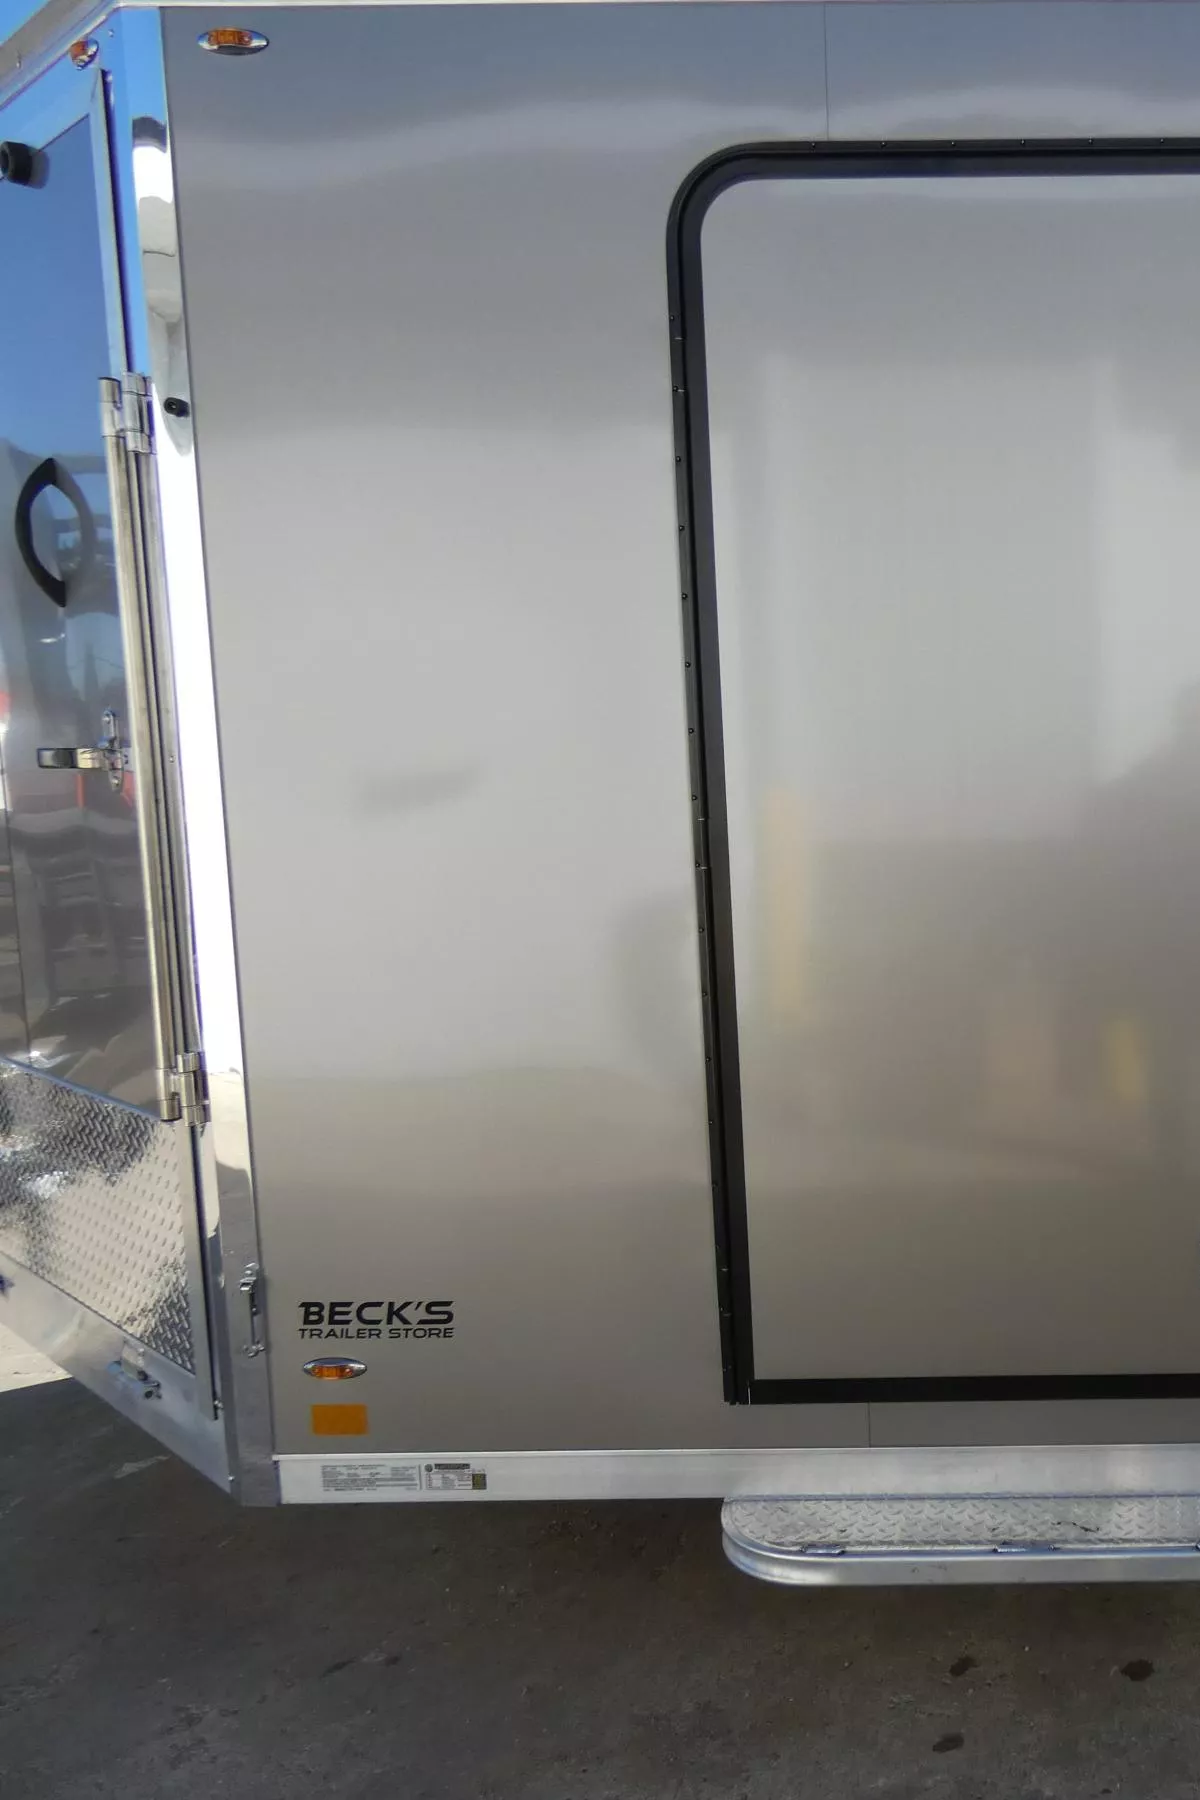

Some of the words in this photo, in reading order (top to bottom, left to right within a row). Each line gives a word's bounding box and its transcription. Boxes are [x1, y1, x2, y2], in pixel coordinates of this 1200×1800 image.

[298, 1300, 455, 1326] BECK'S
[298, 1328, 382, 1340] TRAILER
[388, 1327, 455, 1339] STORE
